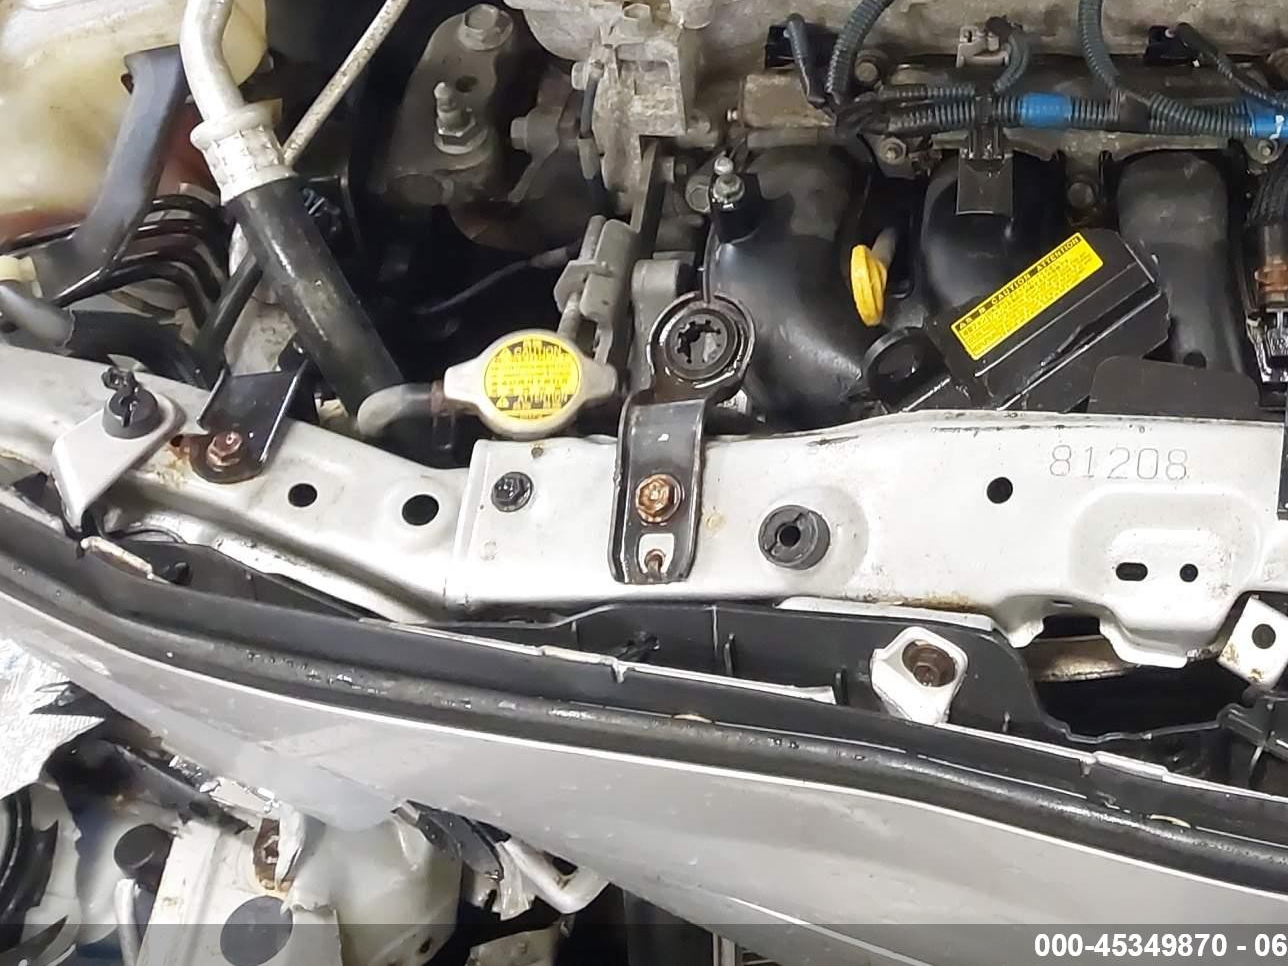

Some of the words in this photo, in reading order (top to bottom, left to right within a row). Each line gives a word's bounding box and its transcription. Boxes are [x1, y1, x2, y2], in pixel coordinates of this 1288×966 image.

[990, 273, 1031, 306] CAUTION
[1035, 237, 1080, 272] ATTENTION
[513, 345, 562, 357] CAUTION
[1049, 444, 1189, 481] 81208
